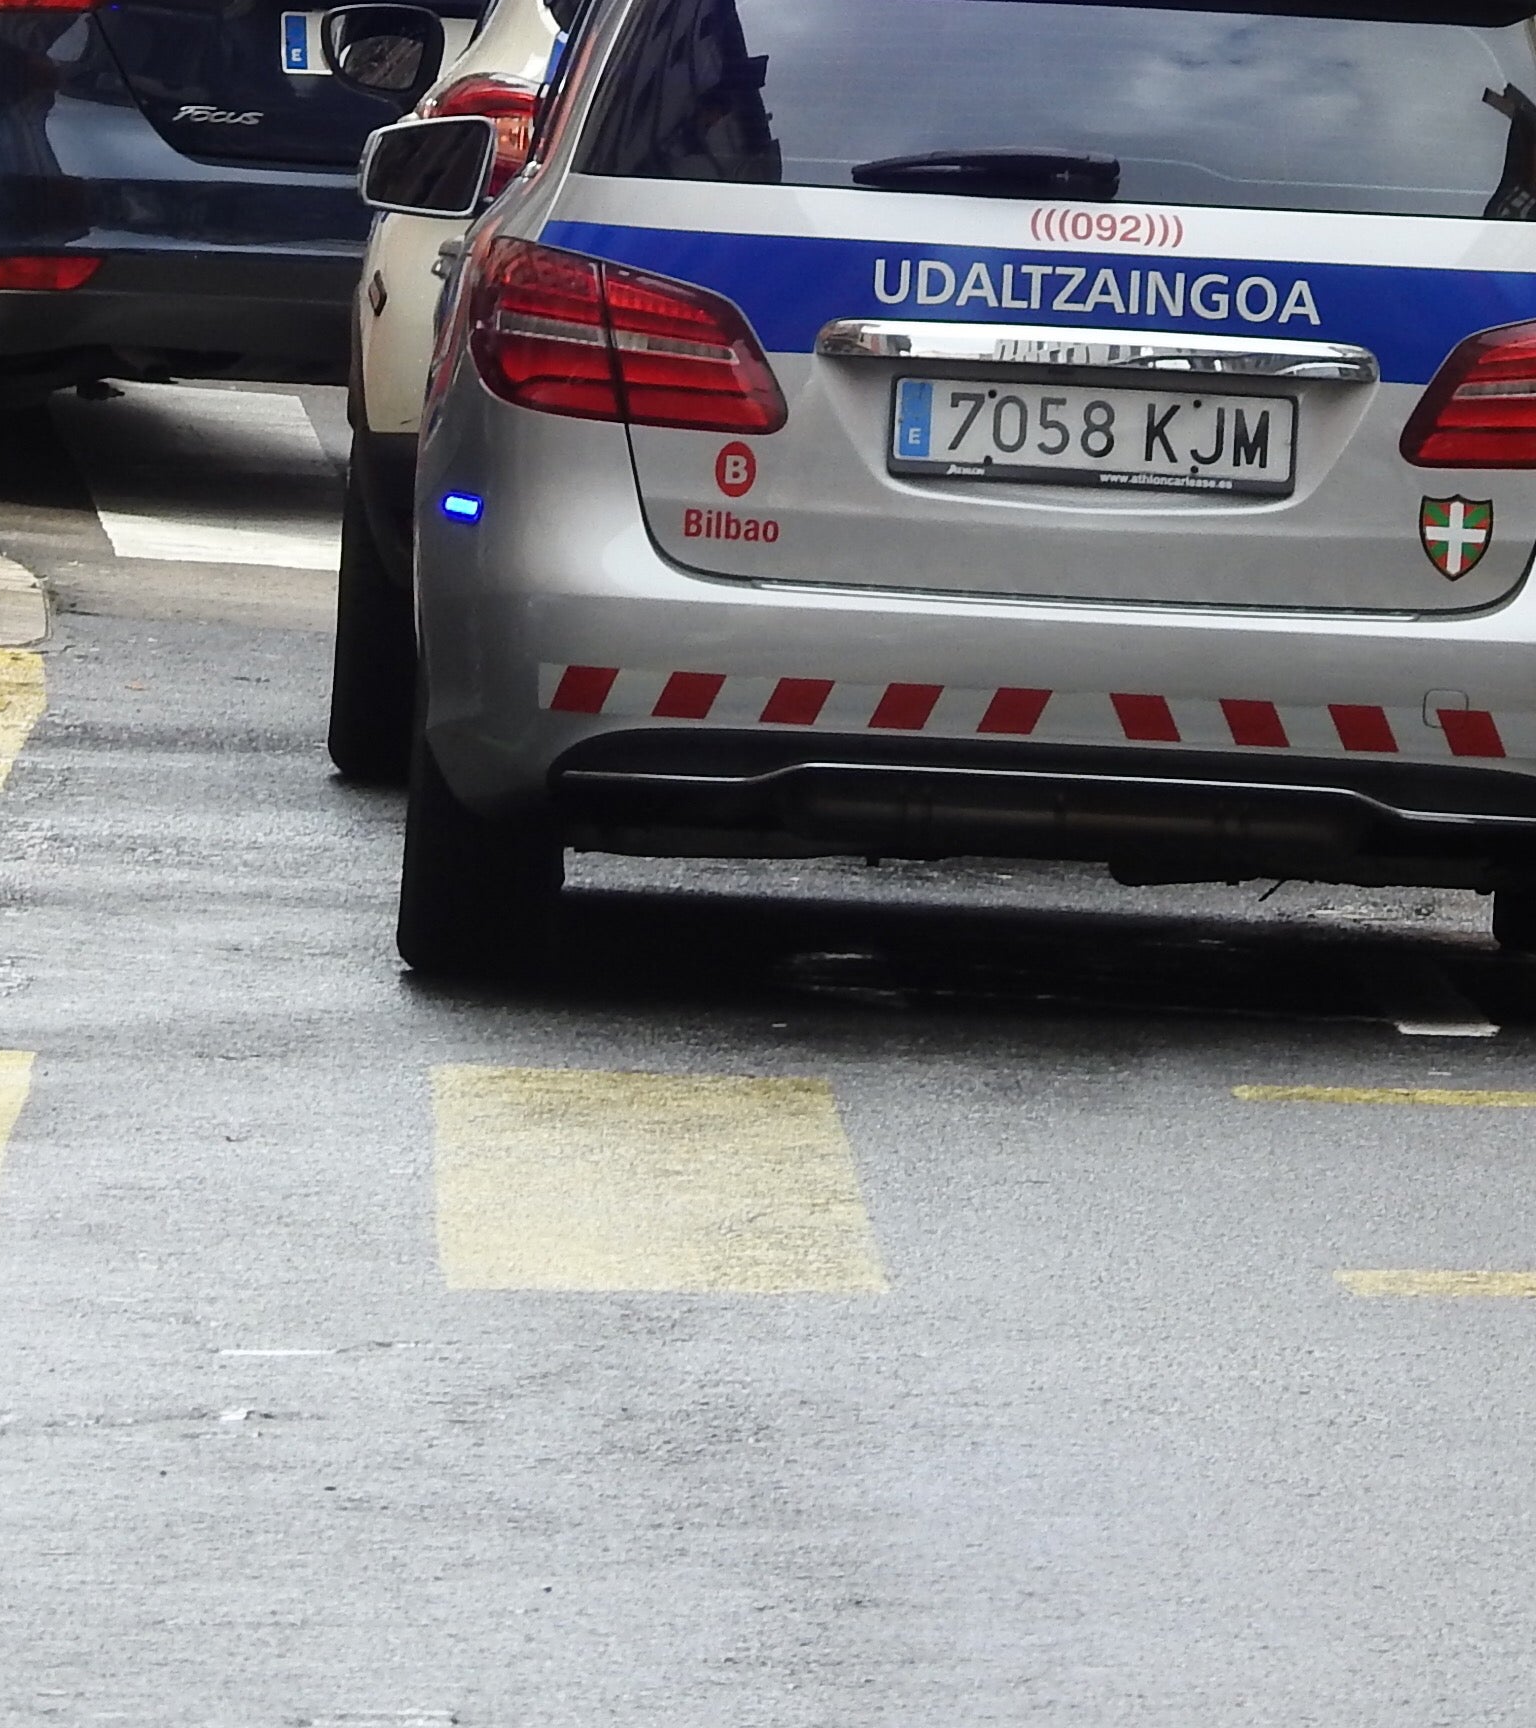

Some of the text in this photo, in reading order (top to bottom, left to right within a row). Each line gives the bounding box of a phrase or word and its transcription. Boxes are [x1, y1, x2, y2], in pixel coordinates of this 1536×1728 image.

[874, 258, 1322, 326] UDALTZAINGOA
[907, 428, 921, 445] E
[947, 391, 1271, 469] 7058 KJM
[725, 455, 749, 485] B
[684, 508, 779, 543] Bilbao
